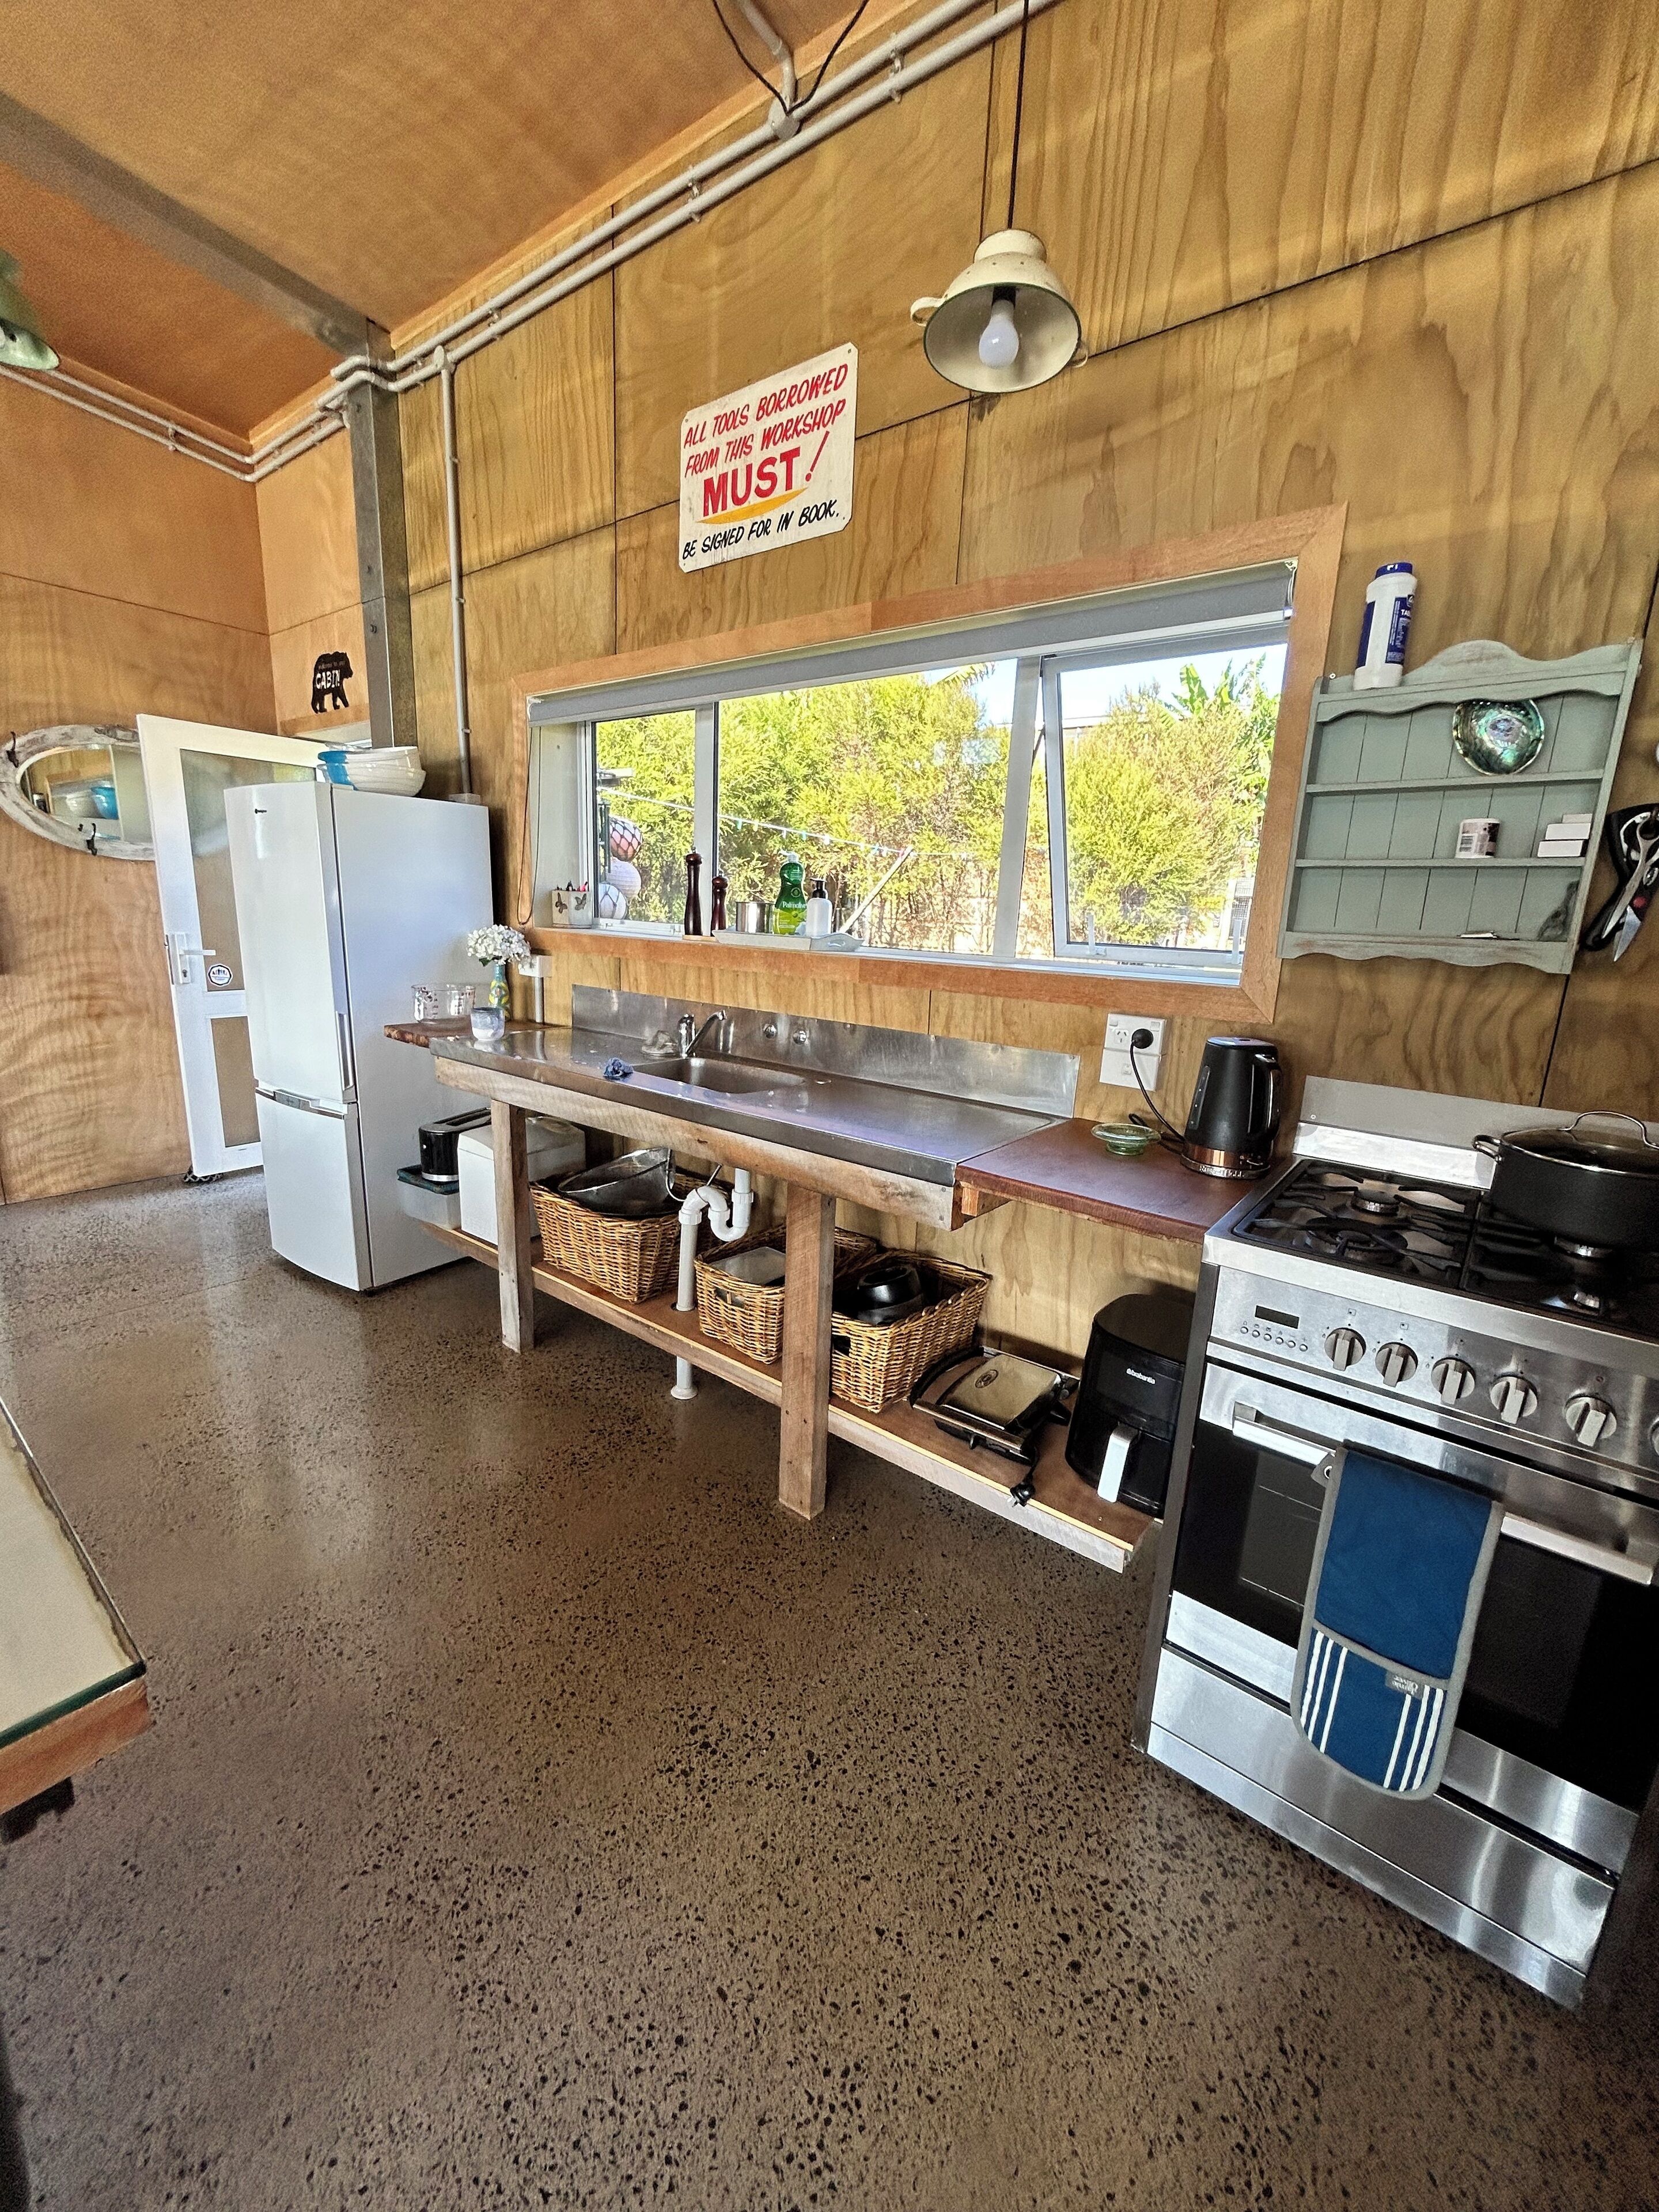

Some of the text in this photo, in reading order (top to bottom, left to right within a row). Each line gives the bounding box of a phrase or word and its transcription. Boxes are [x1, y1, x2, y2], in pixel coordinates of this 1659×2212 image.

[684, 363, 849, 449] ALL TOOLS BORROWED
[684, 398, 846, 478] FROM THIS WORKSHOP
[682, 499, 839, 560] BE SIGNED FOR IN BOOK.
[782, 901, 806, 909] Palmolive
